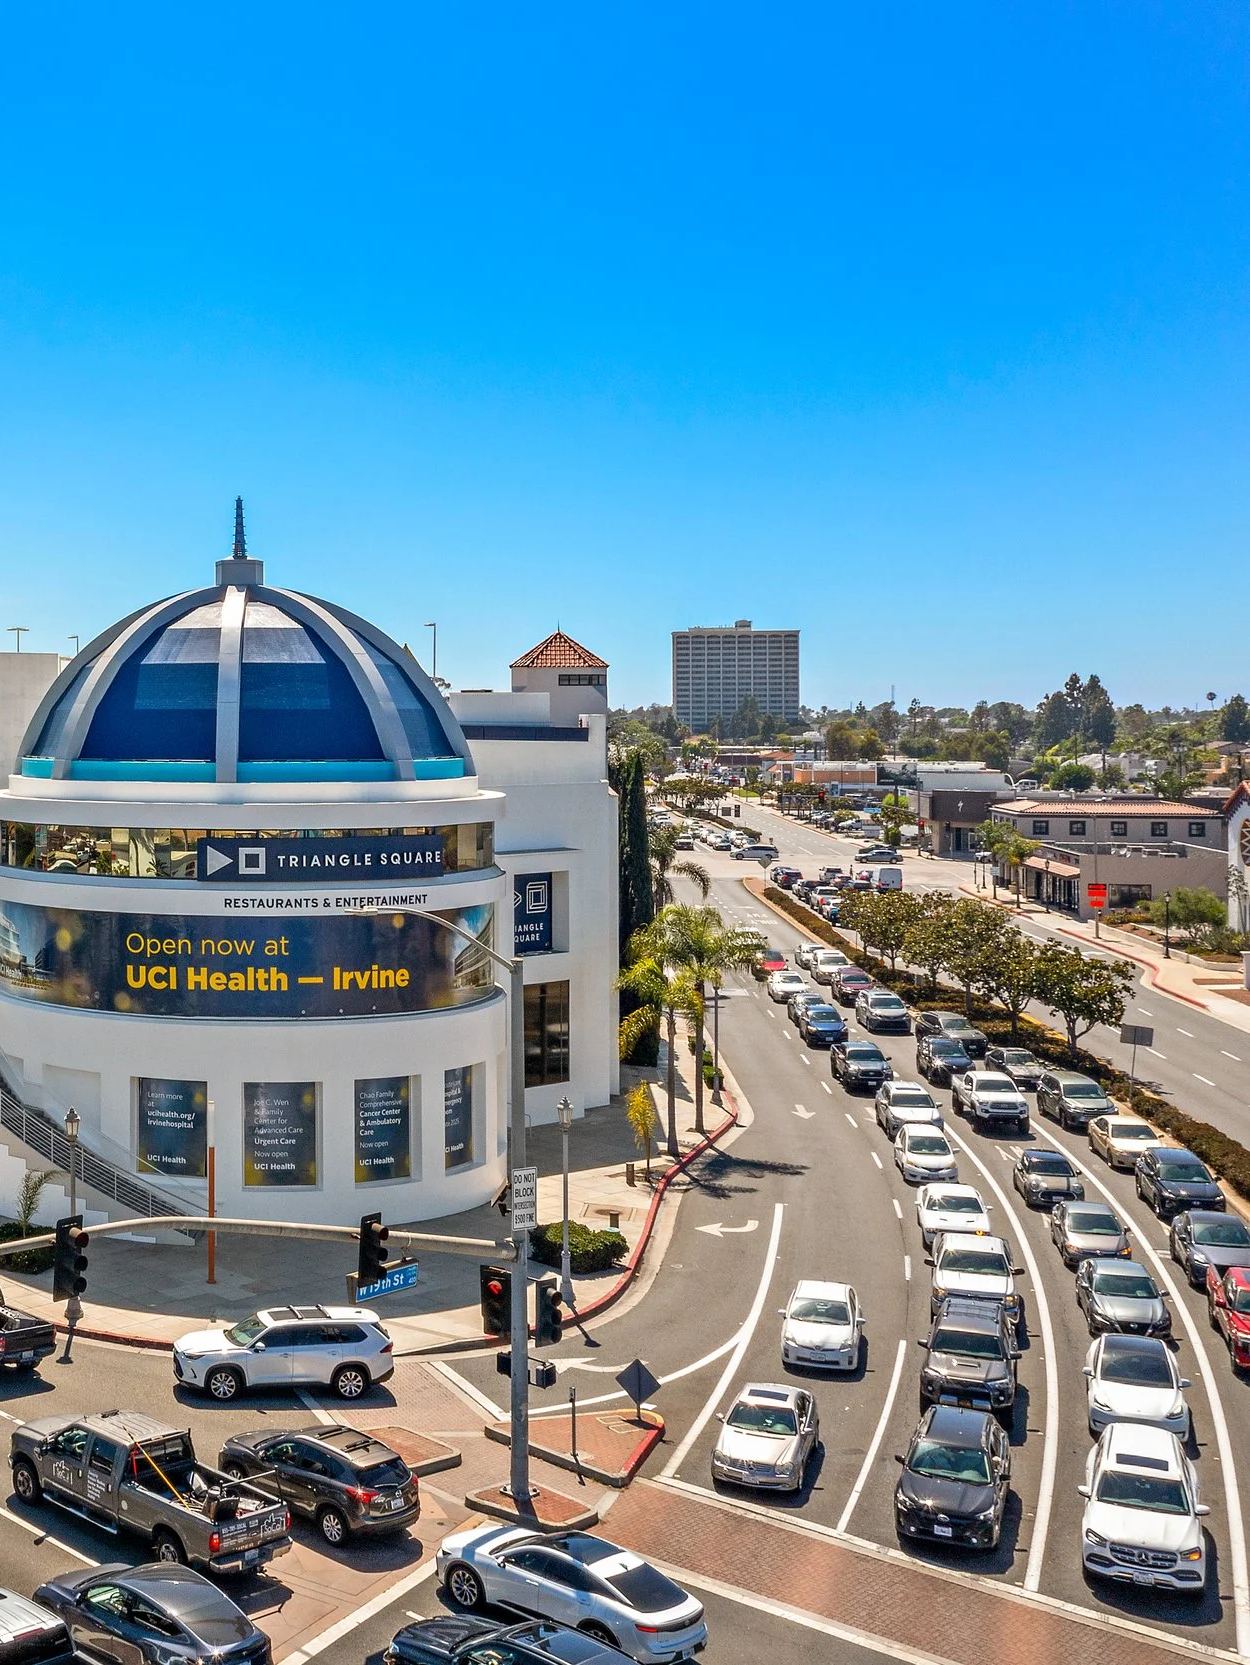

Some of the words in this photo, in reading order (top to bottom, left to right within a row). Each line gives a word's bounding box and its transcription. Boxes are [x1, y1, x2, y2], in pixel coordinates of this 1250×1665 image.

[277, 853, 372, 868] TRIANGLE
[380, 850, 441, 865] SQUARE
[224, 898, 319, 909] RESTAURANTS
[323, 898, 331, 907] &
[336, 894, 428, 908] ENTERTAINMENT
[126, 932, 192, 957] Open
[201, 939, 255, 956] now
[264, 935, 289, 956] at
[126, 965, 177, 990] UCI
[187, 966, 288, 991] Health
[333, 964, 410, 990] Irvine
[147, 1091, 165, 1099] Learn
[375, 1090, 395, 1098] Family
[359, 1099, 402, 1109] Comprehensive
[147, 1110, 196, 1120] ucihealth.org/
[261, 1108, 284, 1116] Family
[359, 1110, 381, 1118] Cancer
[381, 1108, 401, 1116] Center
[147, 1118, 194, 1129] irvinehospital
[366, 1117, 402, 1127] Ambulatory
[254, 1138, 279, 1147] Urgent
[279, 1137, 296, 1145] Care
[359, 1141, 373, 1149] Now
[374, 1140, 389, 1148] open
[147, 1154, 160, 1162] UCI
[162, 1155, 187, 1164] Health
[271, 1151, 288, 1159] open
[373, 1156, 395, 1165] Health
[270, 1162, 296, 1170] Health
[514, 1174, 523, 1184] DO
[524, 1173, 535, 1183] NOT
[514, 1187, 535, 1198] BLOCK
[393, 1273, 405, 1287] St
